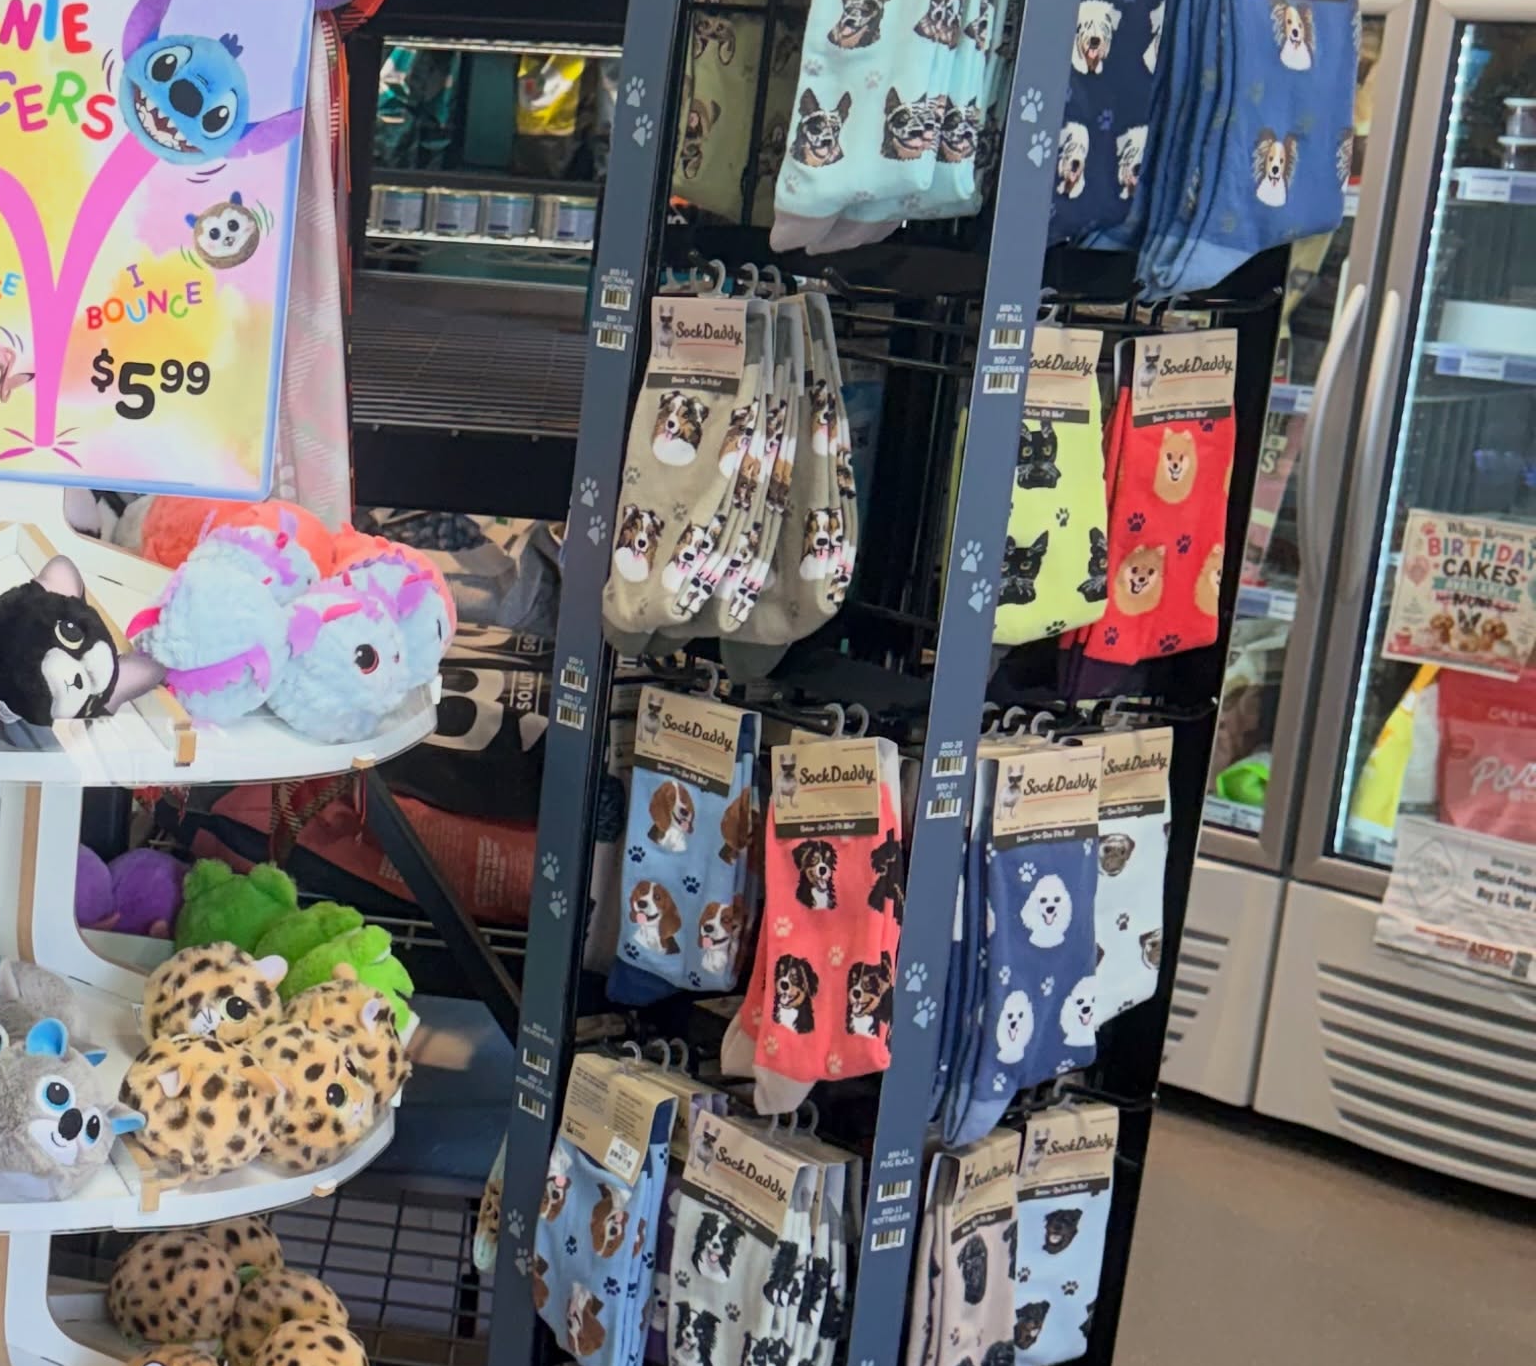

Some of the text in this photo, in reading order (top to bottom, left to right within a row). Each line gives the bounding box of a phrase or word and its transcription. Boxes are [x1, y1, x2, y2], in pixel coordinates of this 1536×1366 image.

[126, 263, 144, 289] I
[86, 280, 203, 330] BOUNCE
[676, 318, 744, 349] SockDaddy
[1029, 348, 1095, 378] ockDaddy
[1160, 355, 1234, 376] SockDaddy
[1442, 557, 1520, 586] CAKES
[661, 709, 736, 754] SockDaddy
[799, 763, 878, 791] SockDaddy
[1023, 772, 1098, 796] SockDaddy
[1047, 1131, 1116, 1159] SockDaddy
[714, 1144, 789, 1205] SockDaddy
